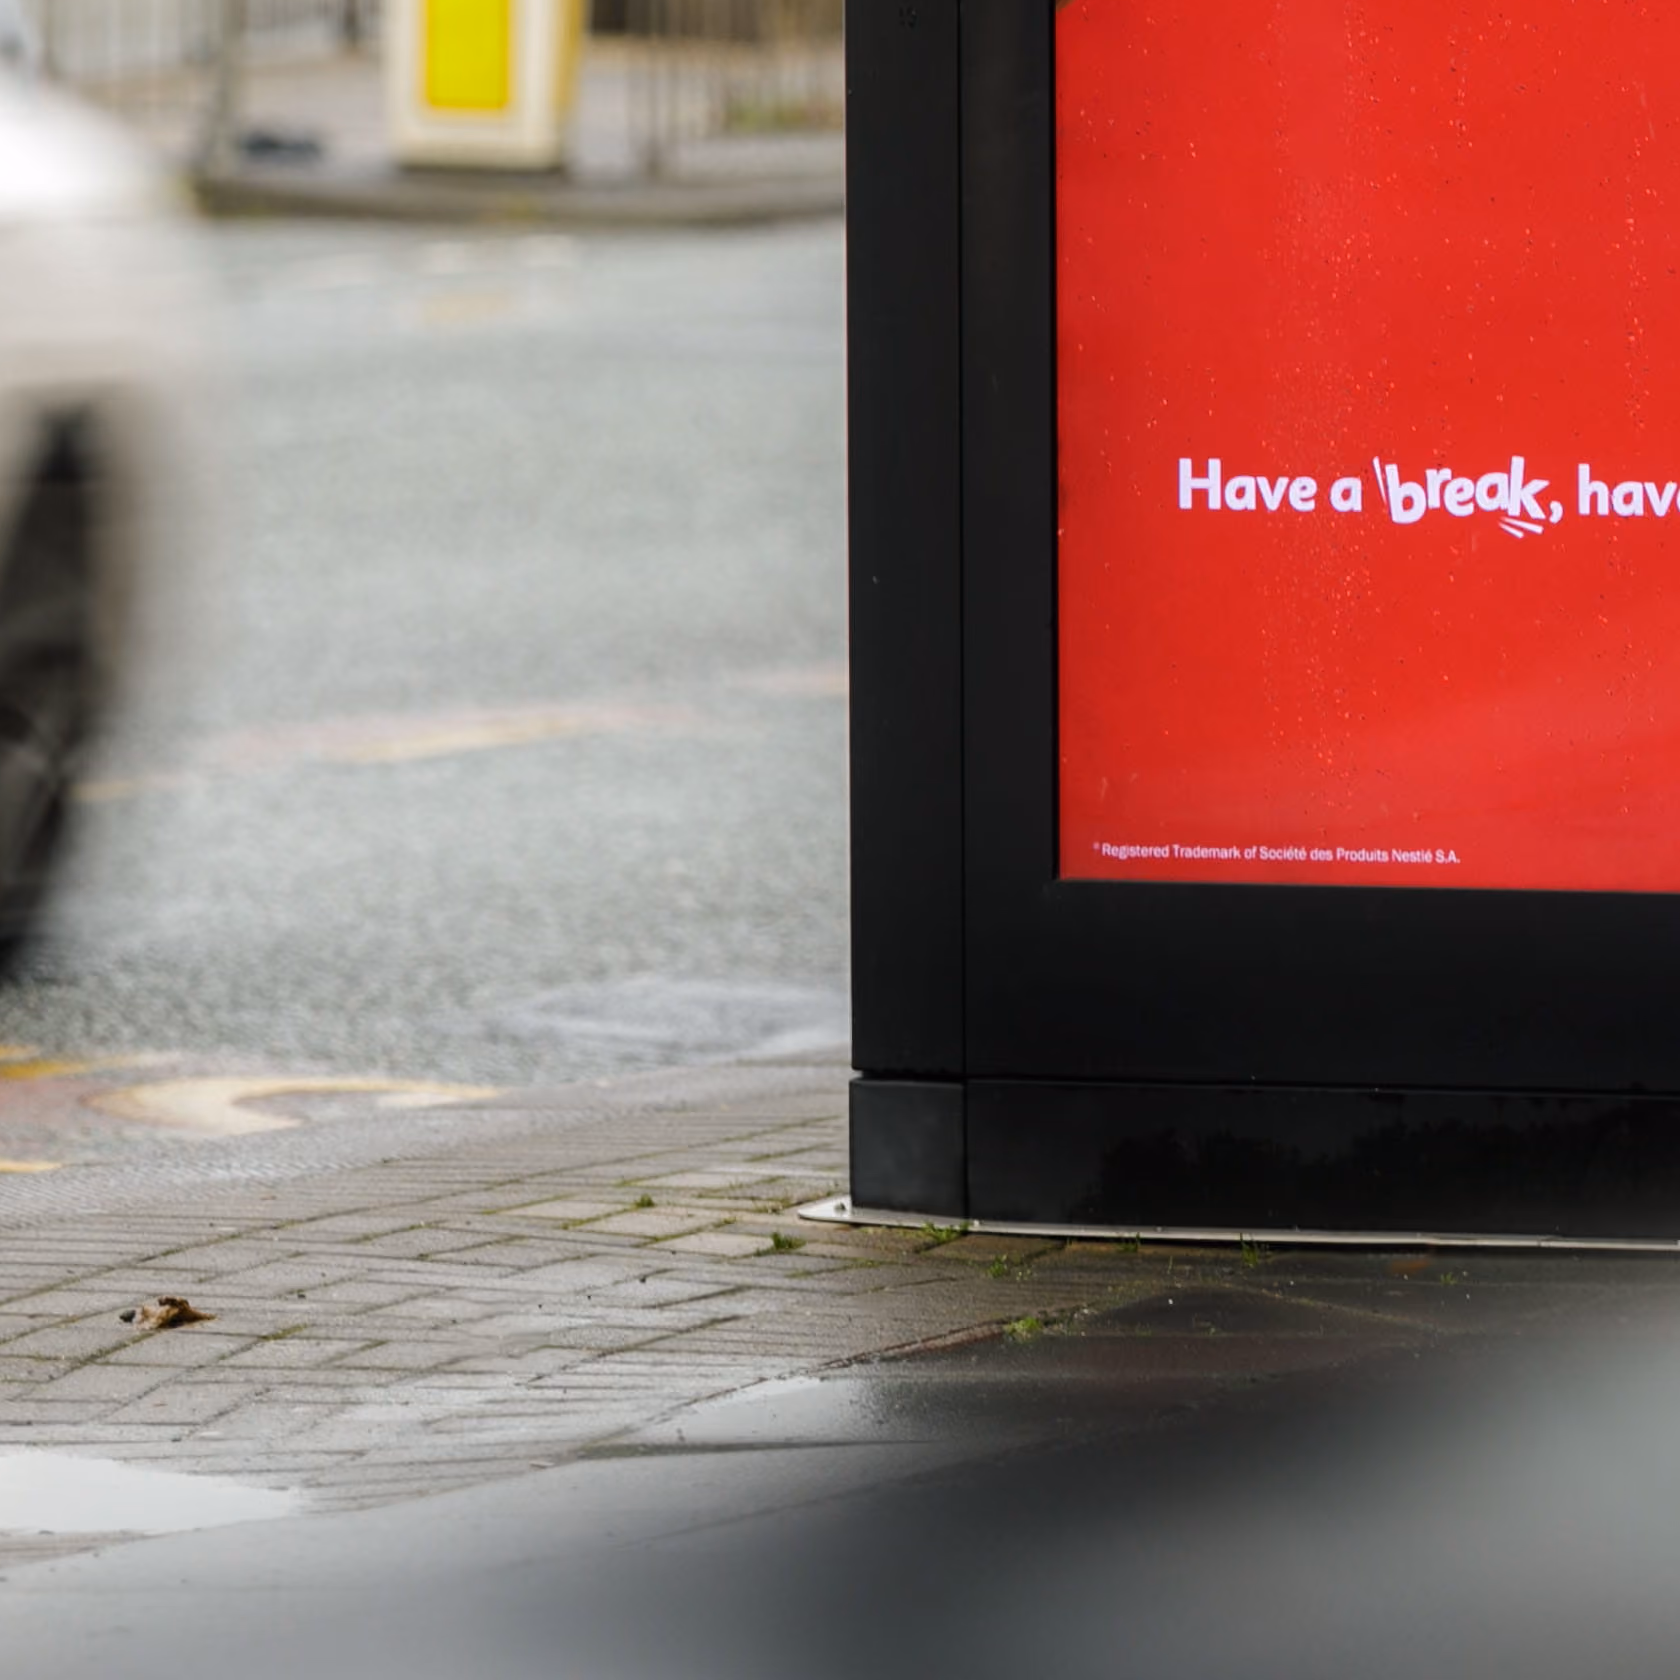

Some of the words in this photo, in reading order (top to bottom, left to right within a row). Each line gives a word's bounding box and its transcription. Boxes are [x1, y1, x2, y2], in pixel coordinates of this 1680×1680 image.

[1178, 458, 1318, 512] Have
[1330, 476, 1362, 512] a
[1384, 456, 1563, 524] break,
[1101, 842, 1170, 860] Registered
[1172, 844, 1241, 859] Trademark
[1243, 845, 1258, 860] of
[1259, 845, 1308, 861] Société
[1309, 847, 1334, 862] des
[1336, 847, 1390, 863] Produits
[1435, 849, 1461, 864] S.A.
